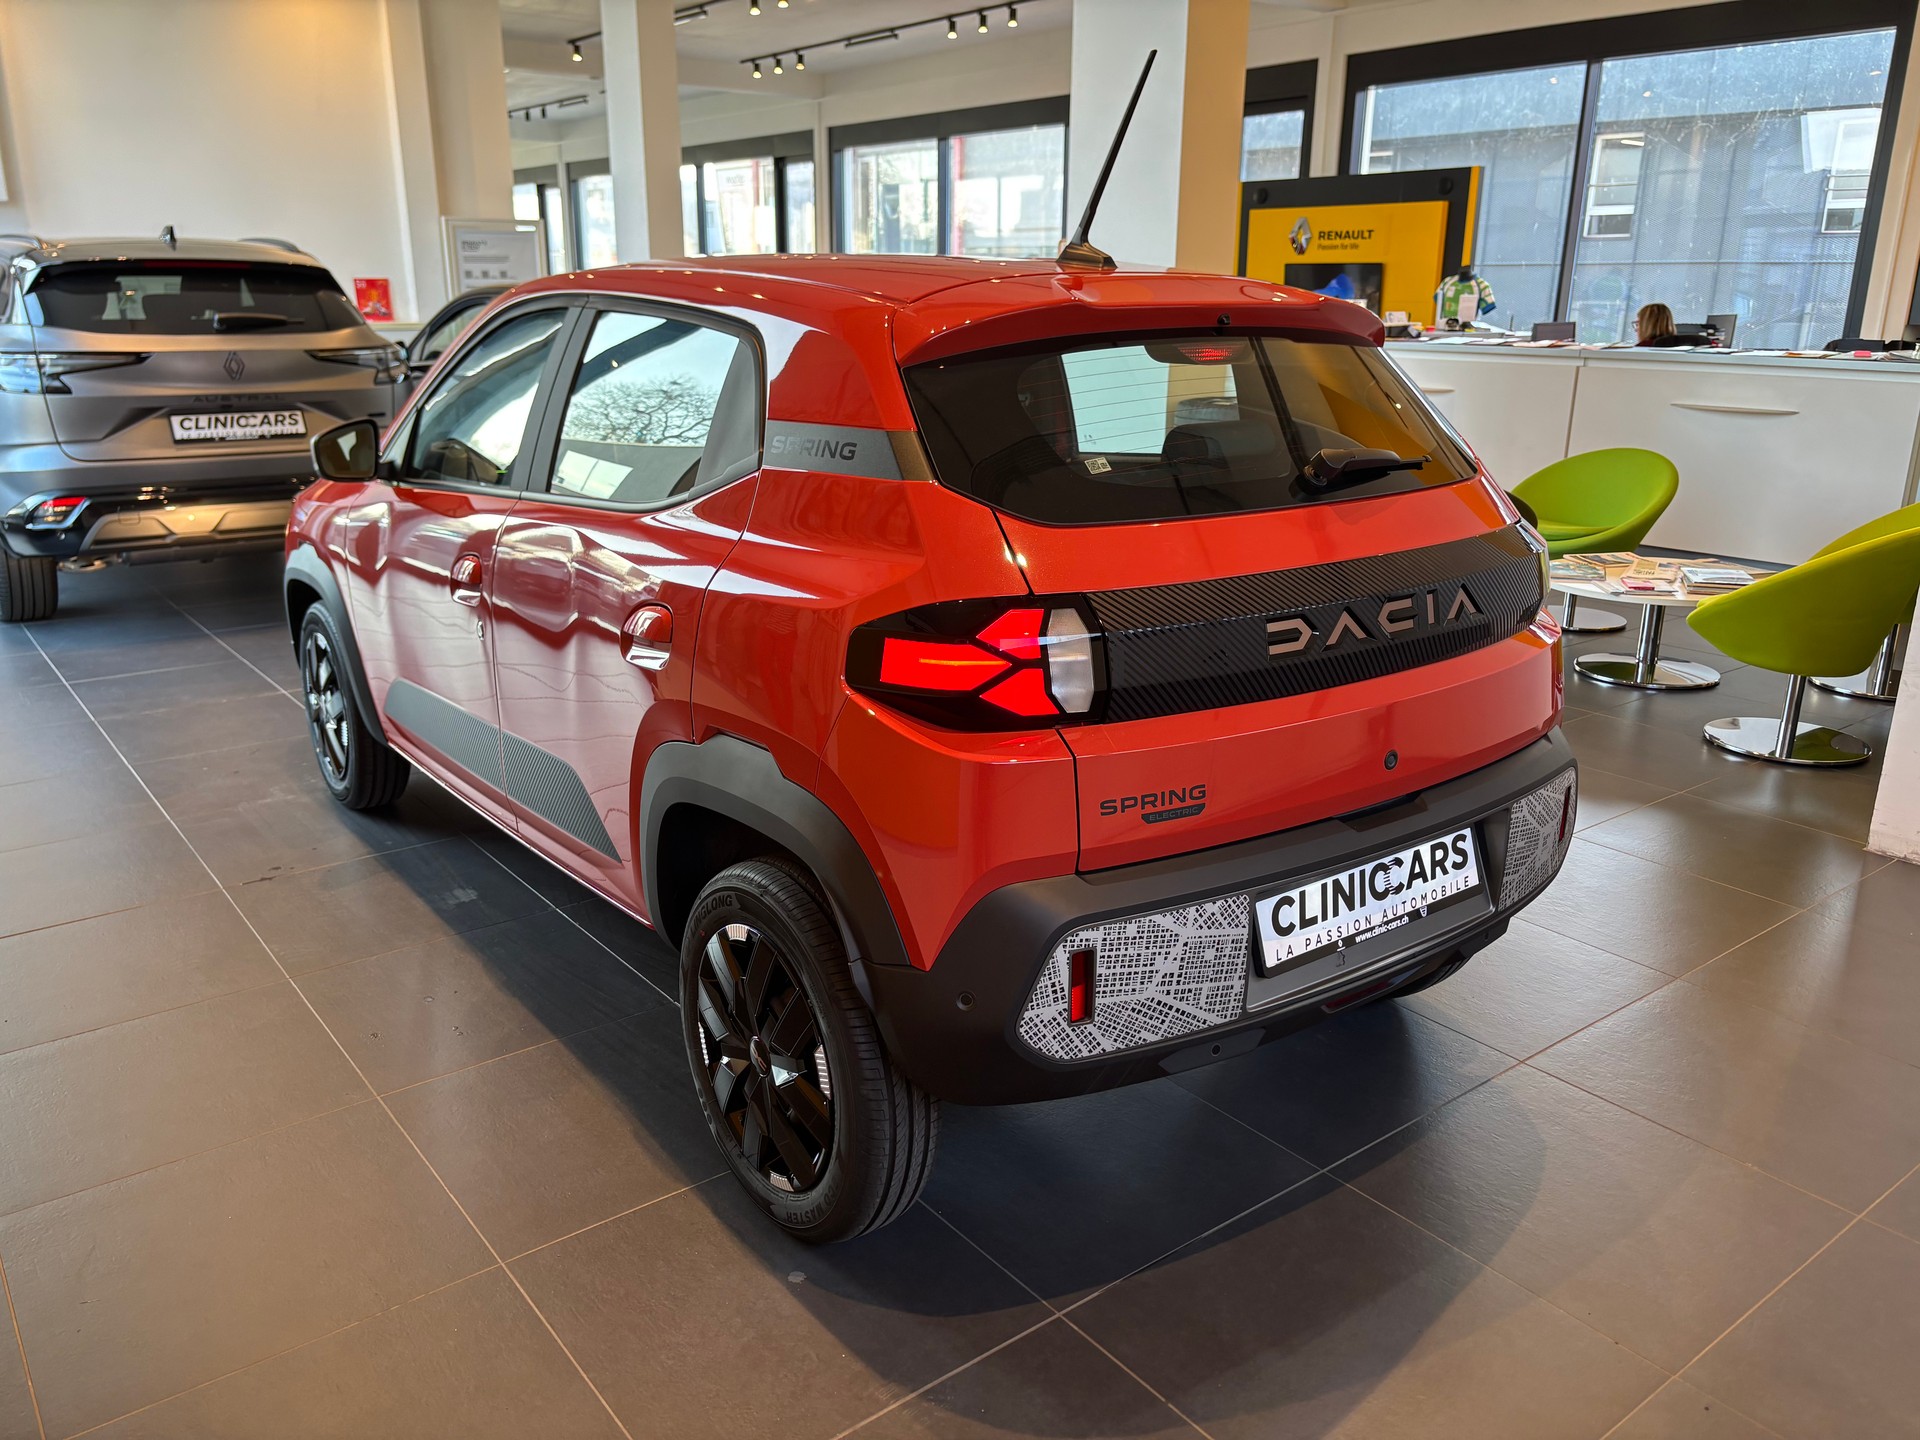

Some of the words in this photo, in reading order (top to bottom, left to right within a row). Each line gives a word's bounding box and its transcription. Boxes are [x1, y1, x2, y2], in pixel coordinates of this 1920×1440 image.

[1318, 229, 1375, 241] RENAULT
[770, 435, 858, 461] SPRING
[1266, 584, 1483, 659] DACIA
[1099, 784, 1206, 817] SPRING
[1149, 806, 1199, 821] ELECTRIC
[1271, 833, 1469, 937] CLINICCARS
[1275, 943, 1294, 962] LA
[1305, 914, 1372, 951] PASSION
[1381, 875, 1470, 920] AUTOMOBILE
[1355, 914, 1410, 943] www.clinic-cars.ch
[786, 1202, 825, 1225] MASTER
